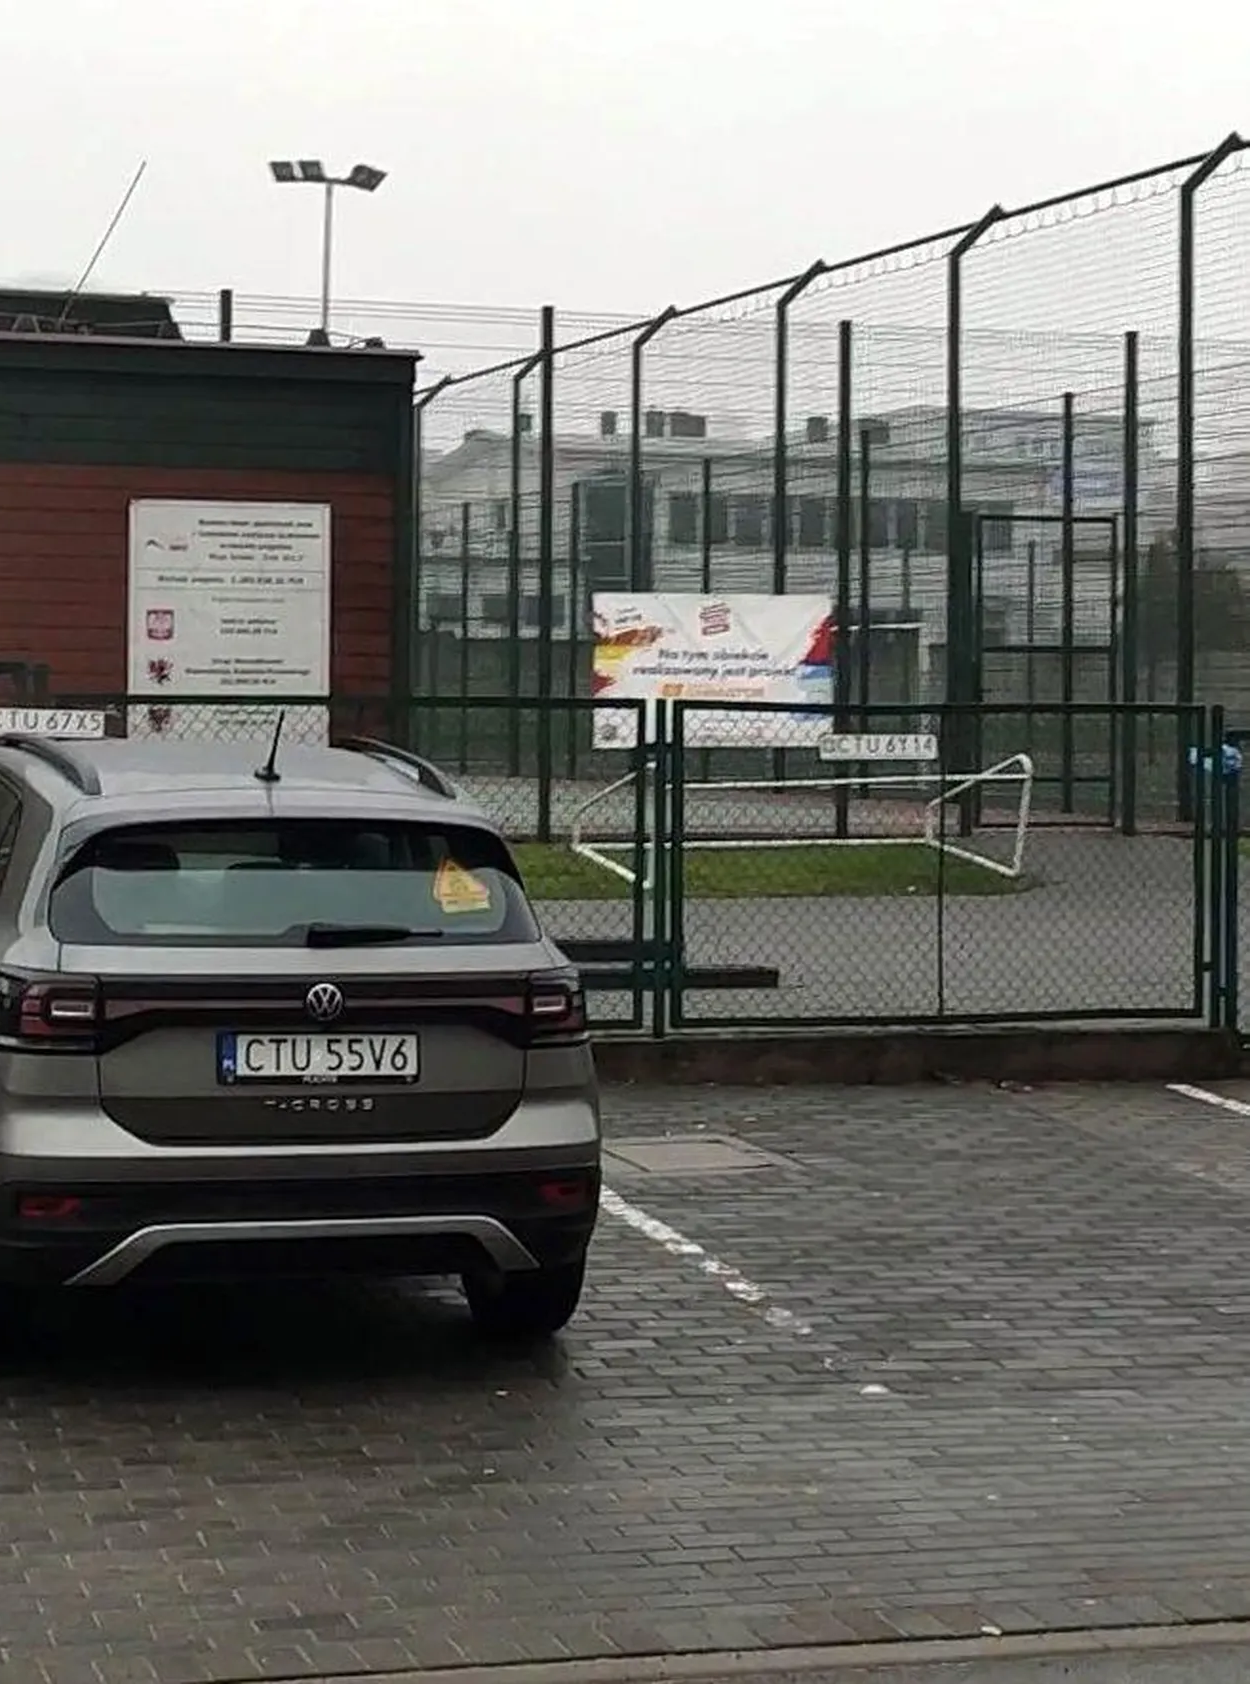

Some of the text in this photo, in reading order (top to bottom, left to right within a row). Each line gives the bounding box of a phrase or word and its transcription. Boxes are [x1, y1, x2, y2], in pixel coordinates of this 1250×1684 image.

[46, 711, 101, 731] 67X5
[836, 736, 880, 753] CTU
[244, 1037, 409, 1072] CTU 55V6
